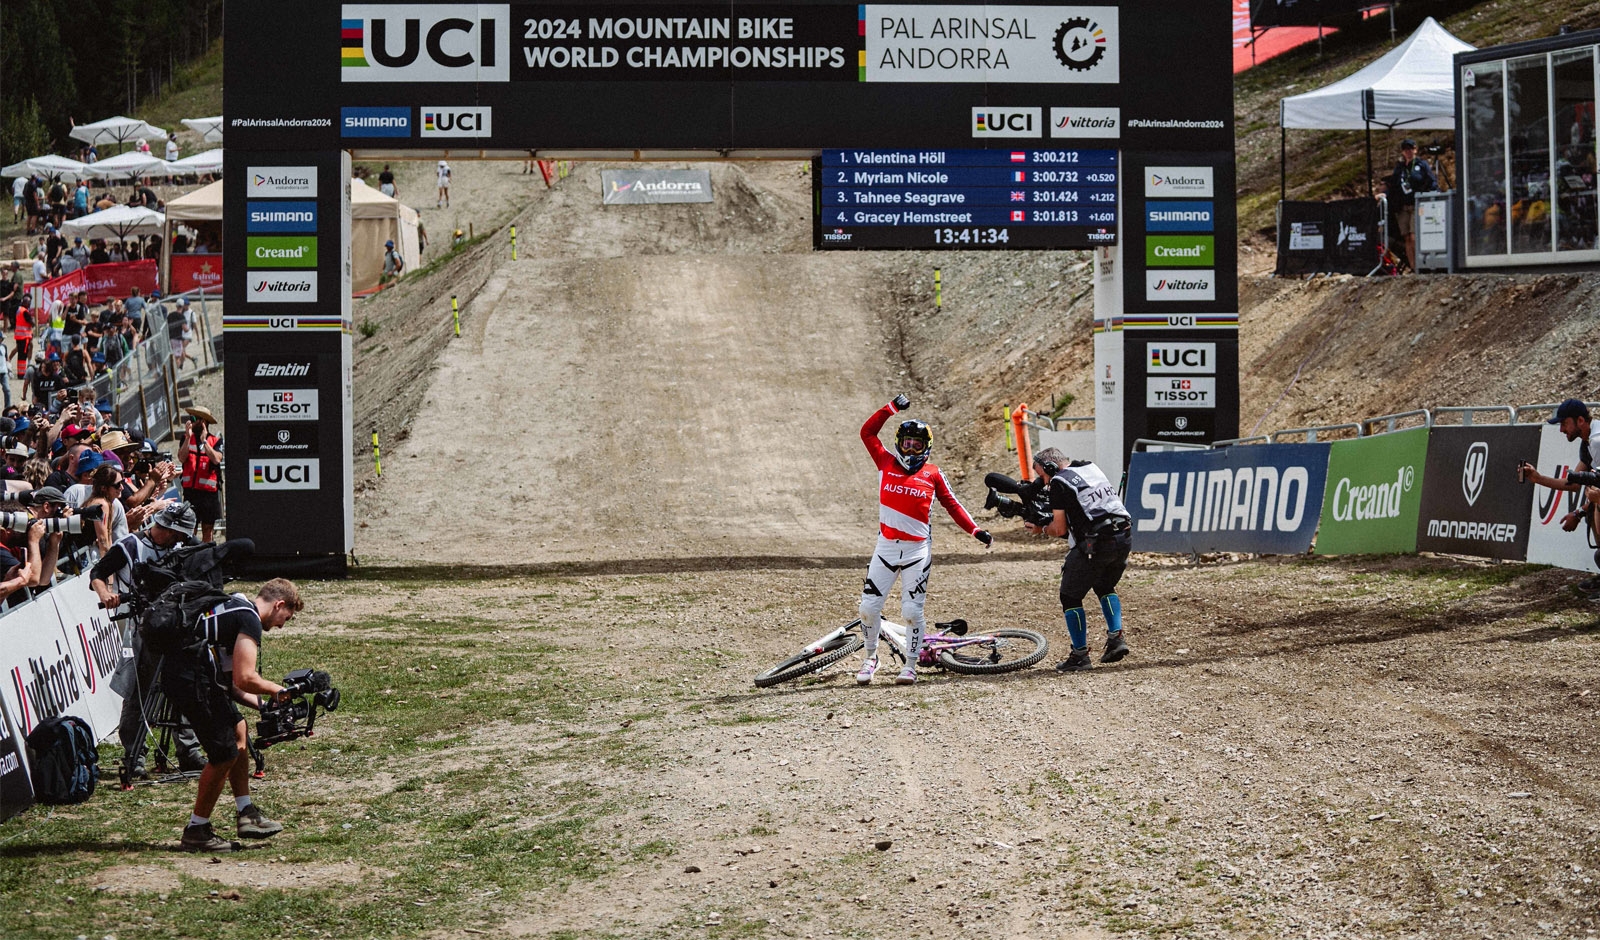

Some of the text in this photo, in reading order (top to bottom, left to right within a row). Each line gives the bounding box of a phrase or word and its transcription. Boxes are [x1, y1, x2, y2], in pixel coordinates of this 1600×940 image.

[524, 18, 794, 40] 2024 MOUNTAIN BIKE
[881, 17, 1036, 40] PAL ARINSAL
[370, 18, 496, 68] UCI
[524, 46, 845, 69] WORLD CHAMPIONSHIPS
[879, 47, 1010, 70] ANDORRA
[231, 118, 332, 128] #PalArinsalAndorra2024
[345, 117, 408, 128] SHIMANO
[435, 113, 482, 131] UCI
[987, 114, 1032, 131] UCI
[1070, 115, 1115, 129] vittoria
[1128, 118, 1224, 129] #PalArinsalAndorra2024
[840, 153, 848, 163] 1.
[854, 152, 915, 164] Valentina
[919, 151, 945, 163] Höll
[1032, 152, 1078, 163] 3:00.212
[267, 175, 309, 185] Andorra
[633, 180, 702, 191] Andorra
[838, 171, 1115, 187] 2. Myriam Nicole 3:00.732 +0.520
[1164, 176, 1205, 185] Andorra
[837, 192, 848, 203] 3.
[854, 192, 901, 203] Tahnee
[904, 192, 965, 206] Seagrave
[1032, 191, 1078, 202] 3:01.424
[251, 212, 313, 222] SHIMANO
[837, 212, 848, 222] 4.
[854, 212, 900, 225] Gracey
[903, 211, 972, 223] Hemstreet
[1032, 210, 1078, 222] 3:01.813
[1150, 211, 1210, 221] SHIMANO
[934, 229, 1009, 243] 13:41:34
[268, 281, 311, 292] vittoria
[1168, 280, 1208, 290] vittoria
[270, 319, 294, 328] UCI
[1169, 317, 1193, 326] UCI
[1162, 349, 1206, 367] UCI
[254, 363, 310, 376] Santini
[1155, 391, 1207, 400] TISSOT
[256, 404, 310, 413] TISSOT
[264, 465, 310, 483] UCI
[884, 484, 927, 499] AUSTRIA
[1088, 489, 1102, 502] TV
[1137, 466, 1308, 532] SHIMANO
[1427, 519, 1517, 543] MONDRAKER
[25, 640, 80, 721] vittoria
